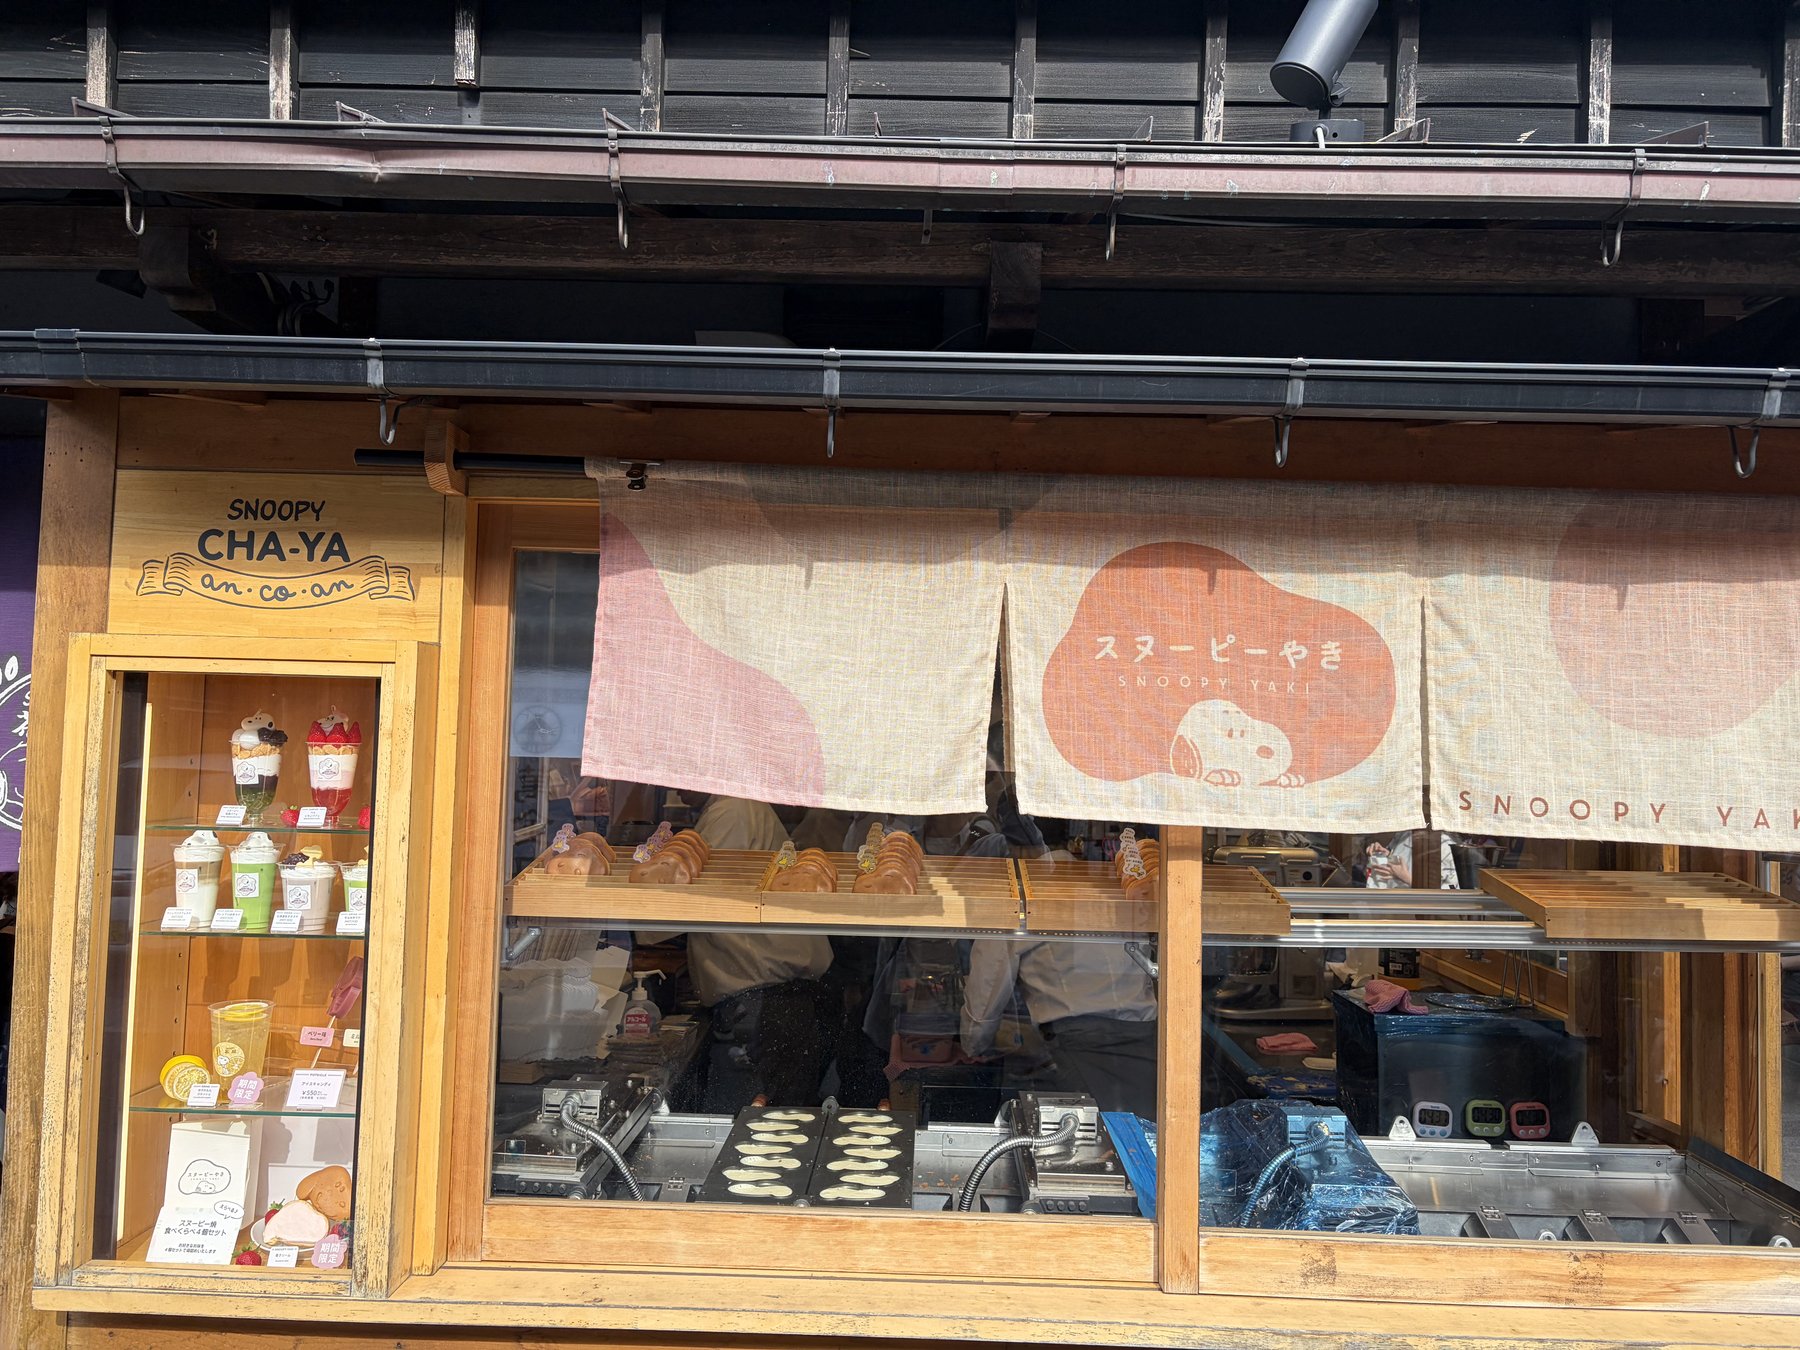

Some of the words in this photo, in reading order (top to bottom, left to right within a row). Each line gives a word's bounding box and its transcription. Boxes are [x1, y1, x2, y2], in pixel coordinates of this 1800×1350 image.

[227, 498, 326, 522] SNOOPY
[197, 528, 351, 563] CHA-YA
[1094, 633, 1343, 671] スヌーピーやき
[1118, 675, 1229, 691] SNOOPY
[1250, 679, 1310, 695] YAKI
[1458, 790, 1667, 824] SNOOPY
[237, 1078, 258, 1090] 期間
[233, 1088, 254, 1100] 限定
[178, 1219, 217, 1228] スヌーピー焼
[320, 1242, 340, 1253] 期間
[317, 1253, 338, 1264] 限定
